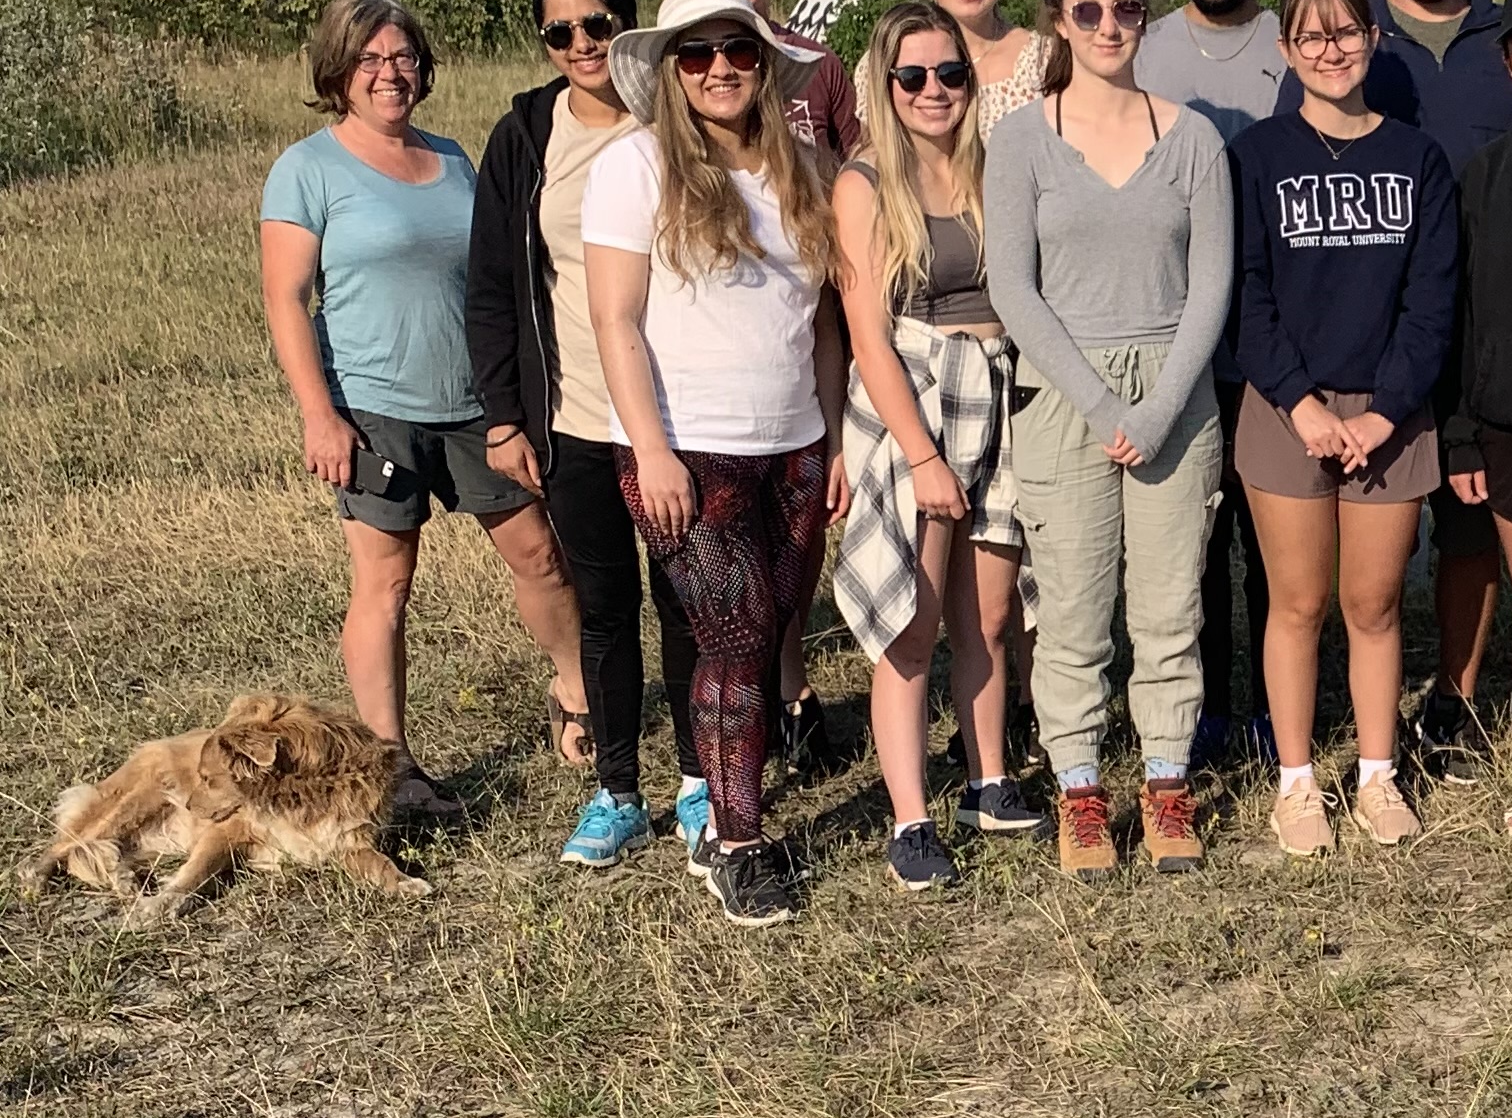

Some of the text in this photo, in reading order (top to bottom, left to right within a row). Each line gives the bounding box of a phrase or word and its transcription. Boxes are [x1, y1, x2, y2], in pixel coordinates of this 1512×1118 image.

[1277, 173, 1414, 238] MRU
[1289, 232, 1406, 249] MOUNT ROYAL UNIVERSITY
